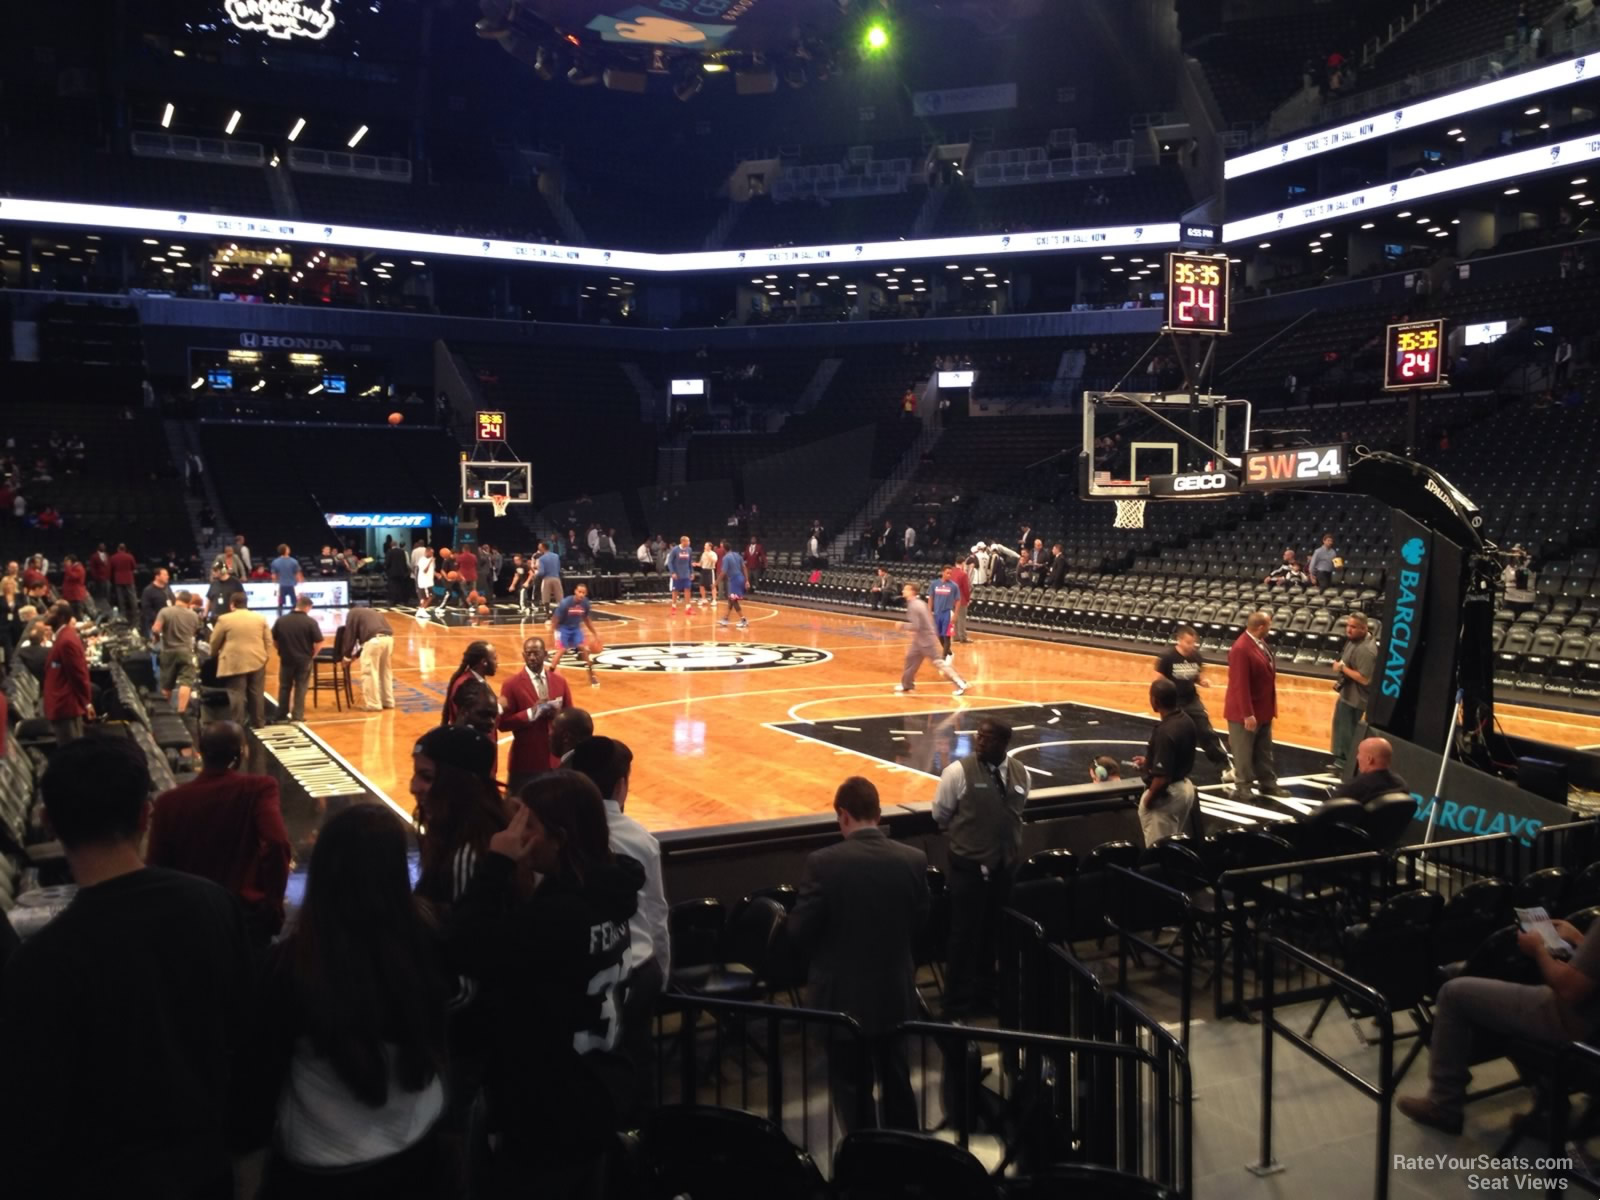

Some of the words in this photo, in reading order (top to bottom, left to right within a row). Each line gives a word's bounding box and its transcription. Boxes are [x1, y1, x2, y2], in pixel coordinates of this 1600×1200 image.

[1175, 262, 1220, 286] 35:35
[1178, 286, 1215, 322] 24
[262, 335, 344, 350] HONDA
[1397, 330, 1438, 352] 35:35
[1402, 352, 1430, 377] 24
[481, 423, 501, 438] 24
[1248, 449, 1343, 481] SW24
[1173, 473, 1226, 491] GEICO
[329, 514, 371, 526] BUD
[370, 514, 426, 526] LIGHT
[1381, 570, 1420, 698] BARCLAYS
